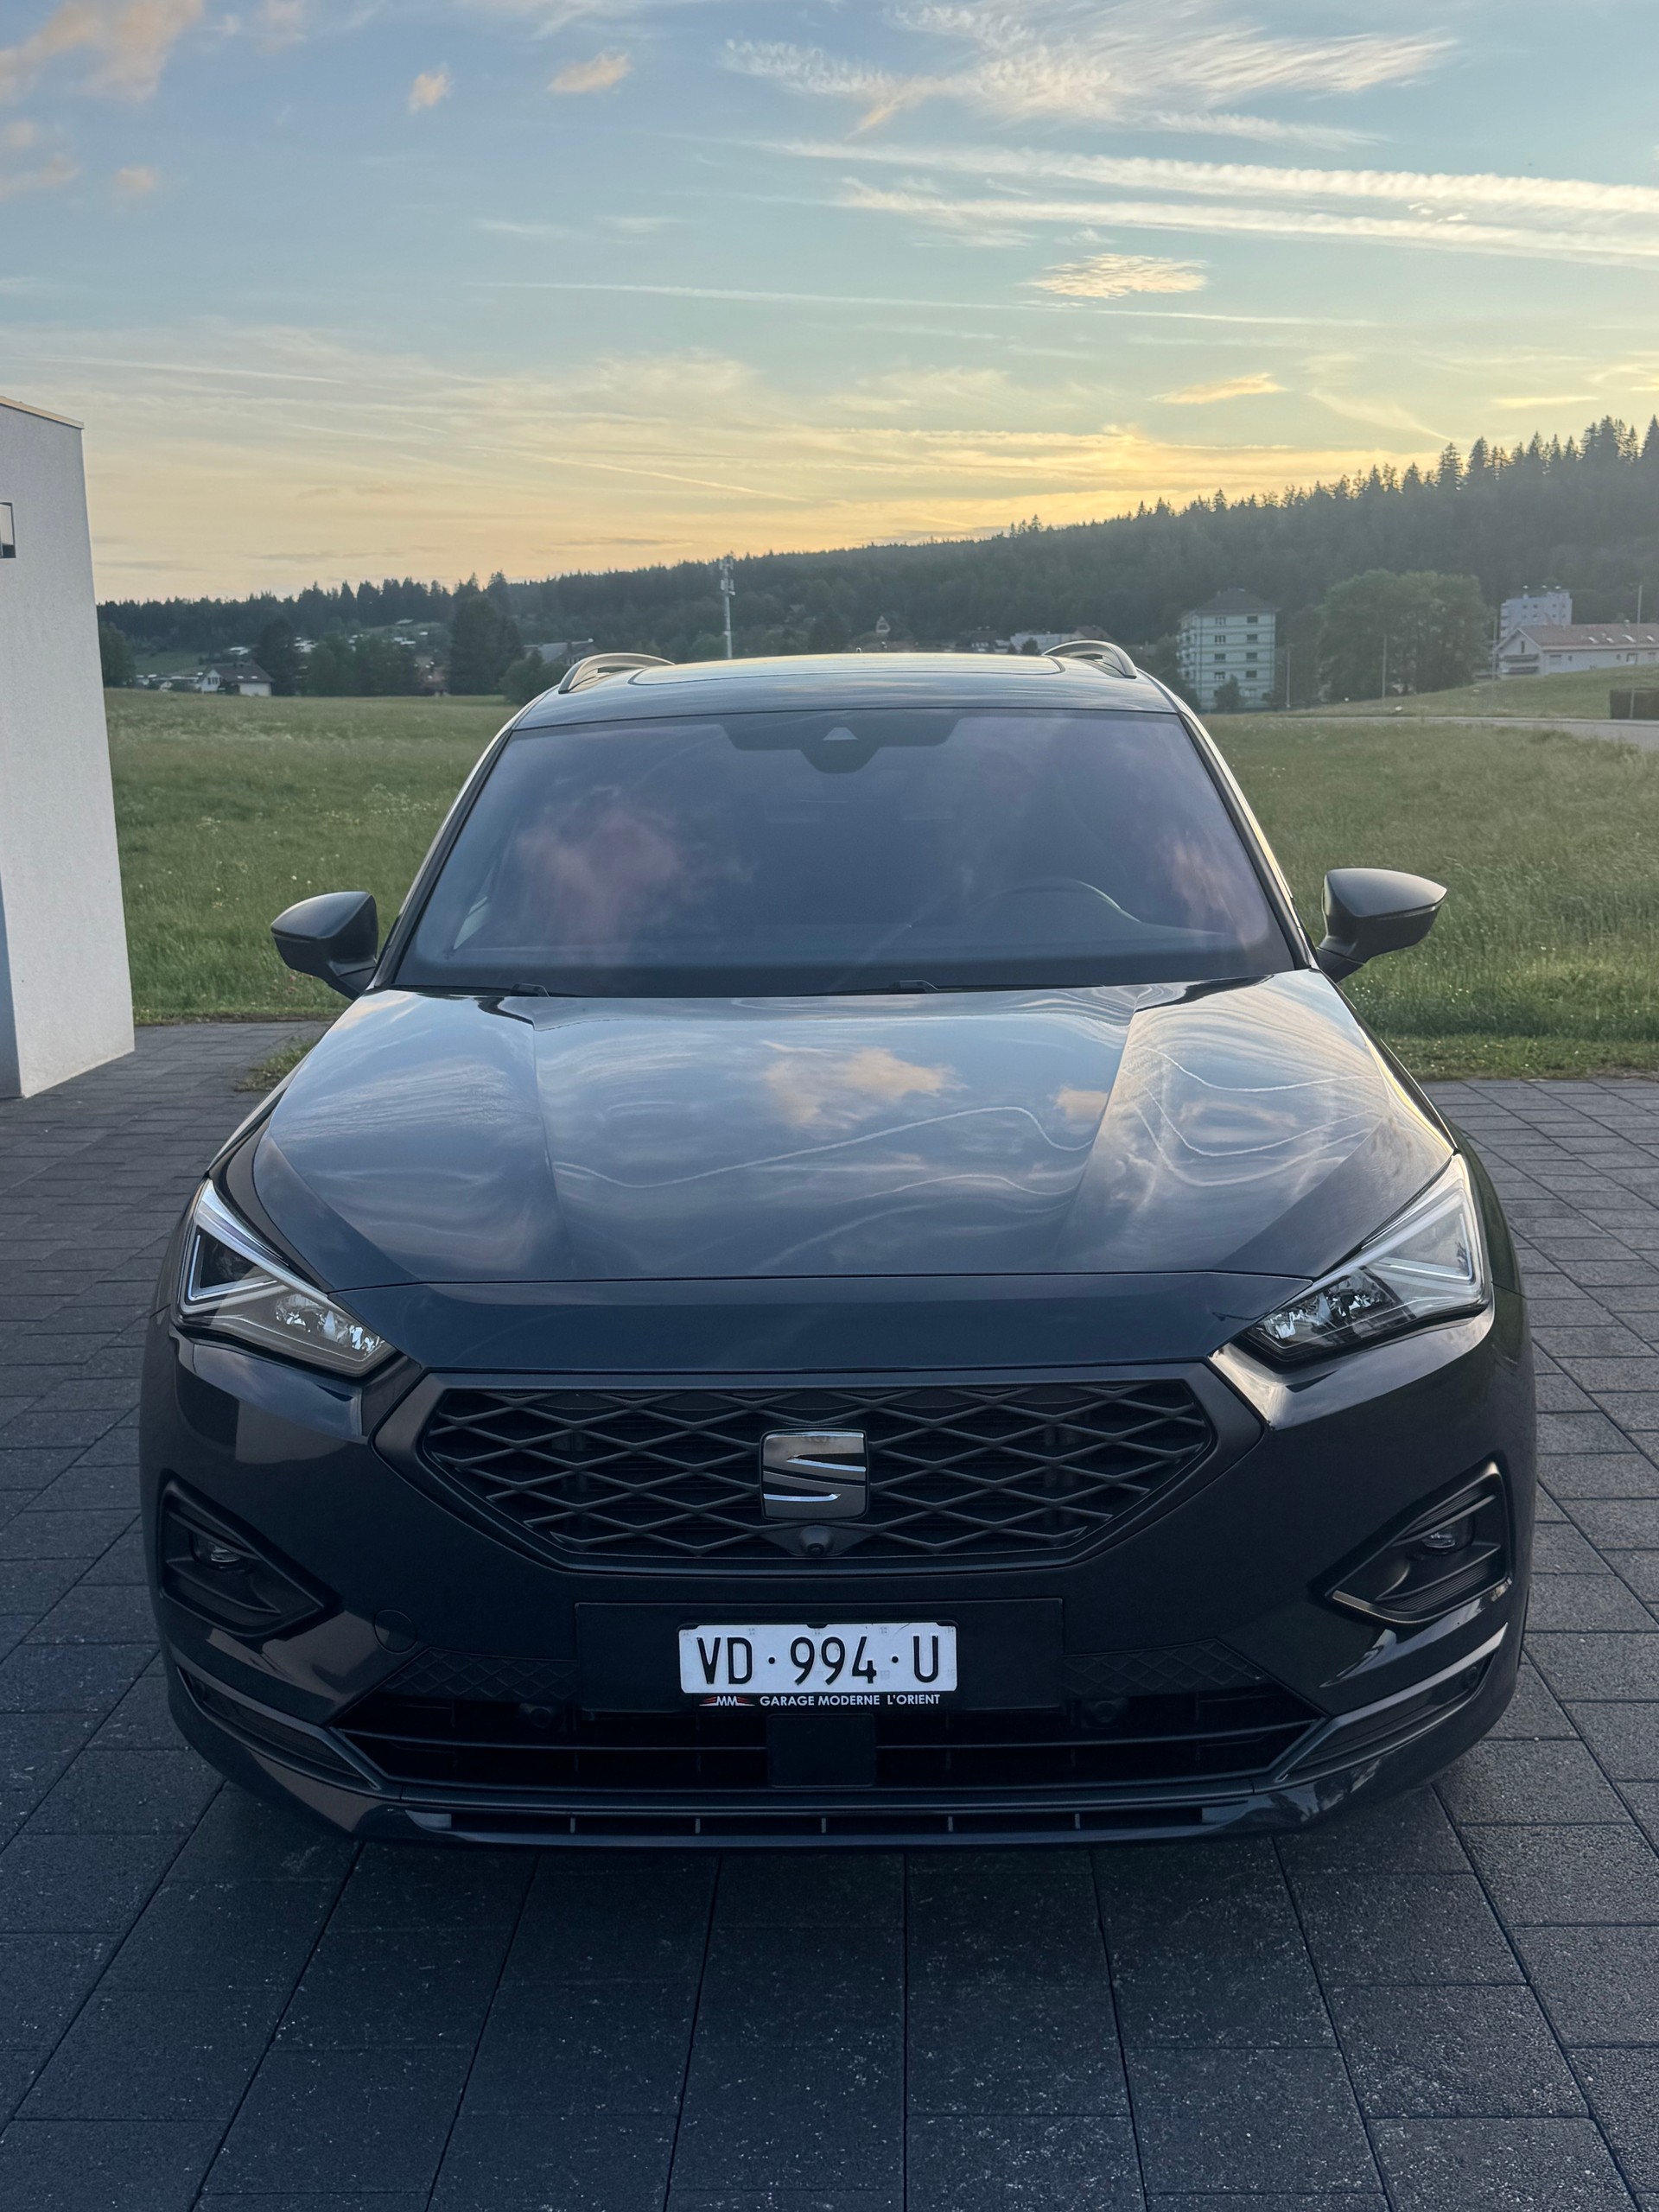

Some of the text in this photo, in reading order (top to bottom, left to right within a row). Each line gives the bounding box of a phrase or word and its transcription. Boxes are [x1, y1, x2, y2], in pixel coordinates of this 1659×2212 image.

[760, 1694, 941, 1707] GARAGE MODERNE L'ORIENT
